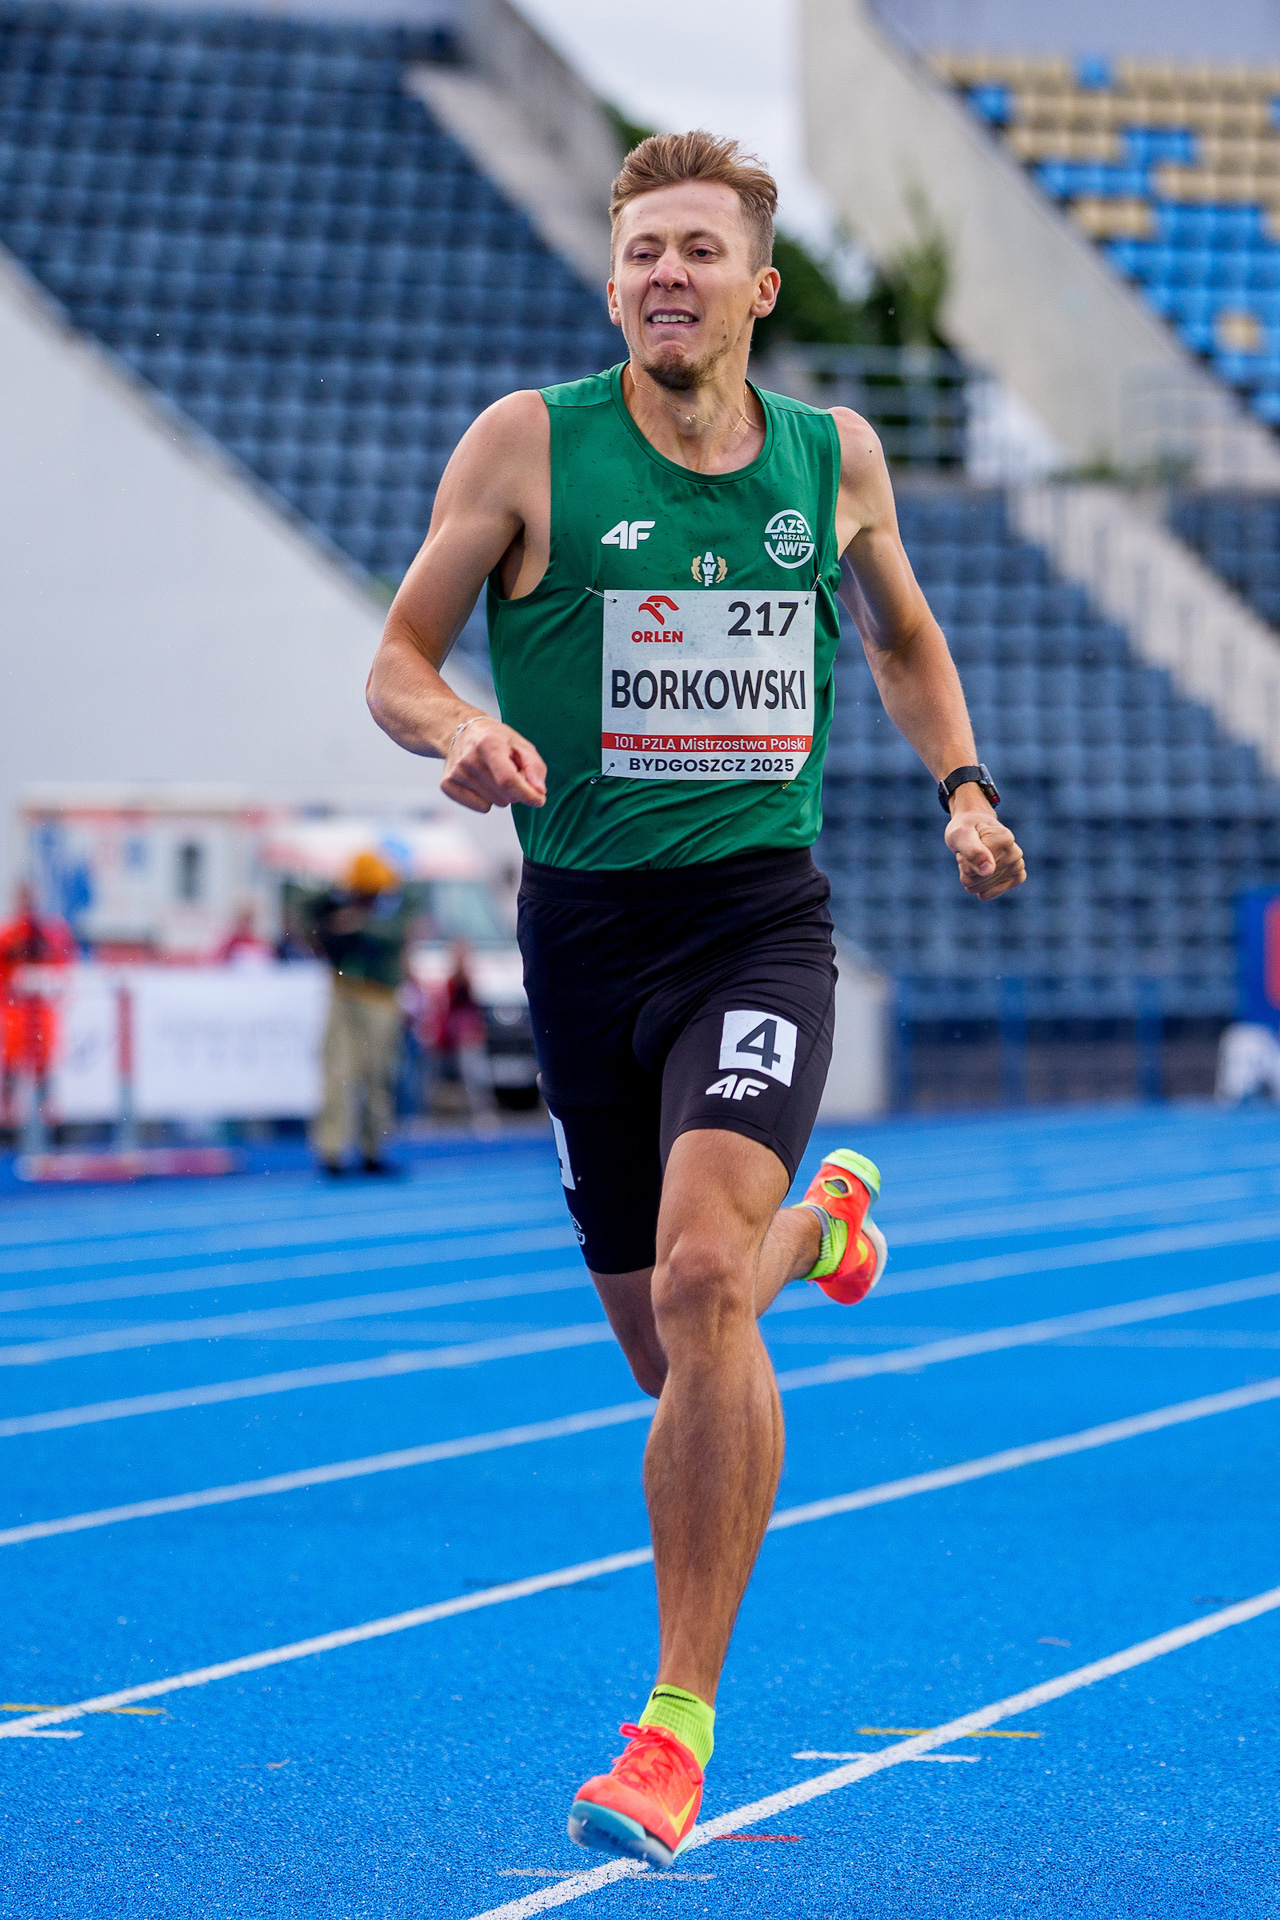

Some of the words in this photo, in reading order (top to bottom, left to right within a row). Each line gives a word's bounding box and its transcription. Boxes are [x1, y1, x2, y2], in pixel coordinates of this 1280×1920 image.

[776, 519, 805, 534] AZS
[601, 520, 656, 550] 4F
[771, 534, 811, 542] WARSZAWA
[775, 541, 808, 557] AWF
[727, 600, 800, 637] 217
[631, 630, 684, 643] ORLEN
[611, 669, 807, 710] BORKOWSKI
[614, 735, 638, 749] 101.
[641, 738, 676, 750] PZLA
[680, 737, 767, 751] Mistrzostwa
[770, 738, 807, 751] Polski
[628, 757, 746, 772] BYDGOSZCZ
[750, 758, 795, 773] 2025
[735, 1018, 782, 1071] 4
[705, 1074, 769, 1101] 4F
